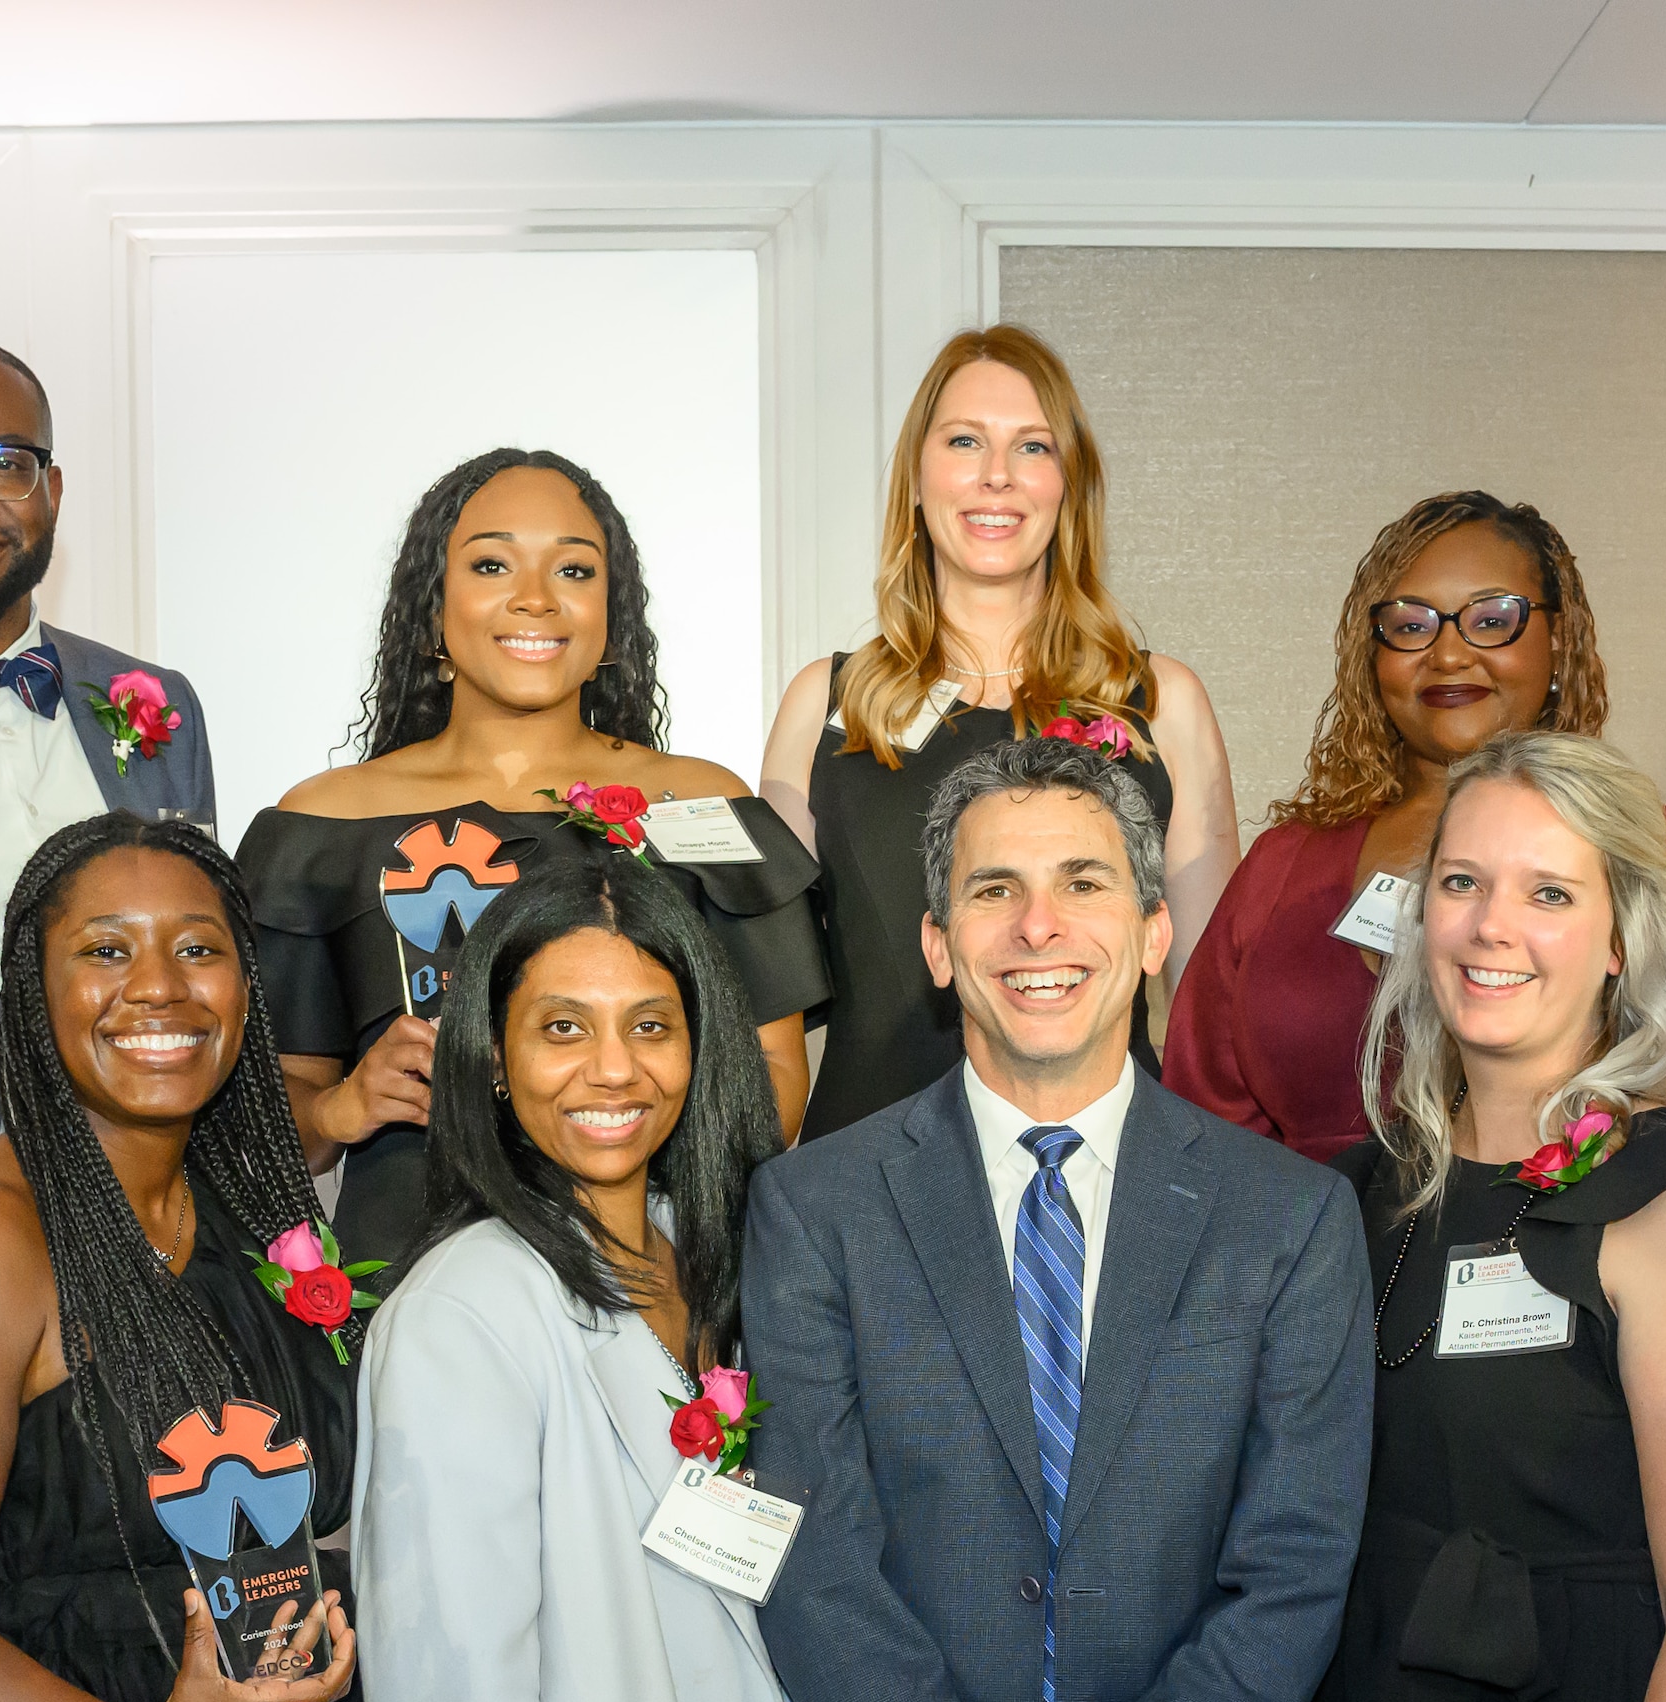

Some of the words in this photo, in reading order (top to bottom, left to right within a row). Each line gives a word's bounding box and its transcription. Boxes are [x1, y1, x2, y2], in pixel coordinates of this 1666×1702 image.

[1477, 1269, 1510, 1278] LEADERS
[1478, 1261, 1517, 1271] EMERGING
[1462, 1320, 1475, 1329] Dr.
[1477, 1316, 1521, 1328] Christina
[1522, 1311, 1551, 1323] Brown
[1448, 1341, 1479, 1351] Atlantic
[1481, 1338, 1528, 1350] Permanente
[1529, 1332, 1560, 1344] Medical
[1458, 1330, 1483, 1340] Kaiser
[1484, 1327, 1533, 1338] Permanente,
[1535, 1324, 1552, 1332] Mid-
[658, 1531, 689, 1553] BROWN
[742, 1572, 762, 1584] LEVY
[674, 1526, 712, 1551] Chelsea
[715, 1547, 757, 1570] Crawford
[242, 1565, 309, 1590] EMERGING
[245, 1580, 301, 1602] LEADERS
[240, 1626, 277, 1642] Cariema
[278, 1619, 304, 1634] Wood
[264, 1638, 288, 1650] 2024
